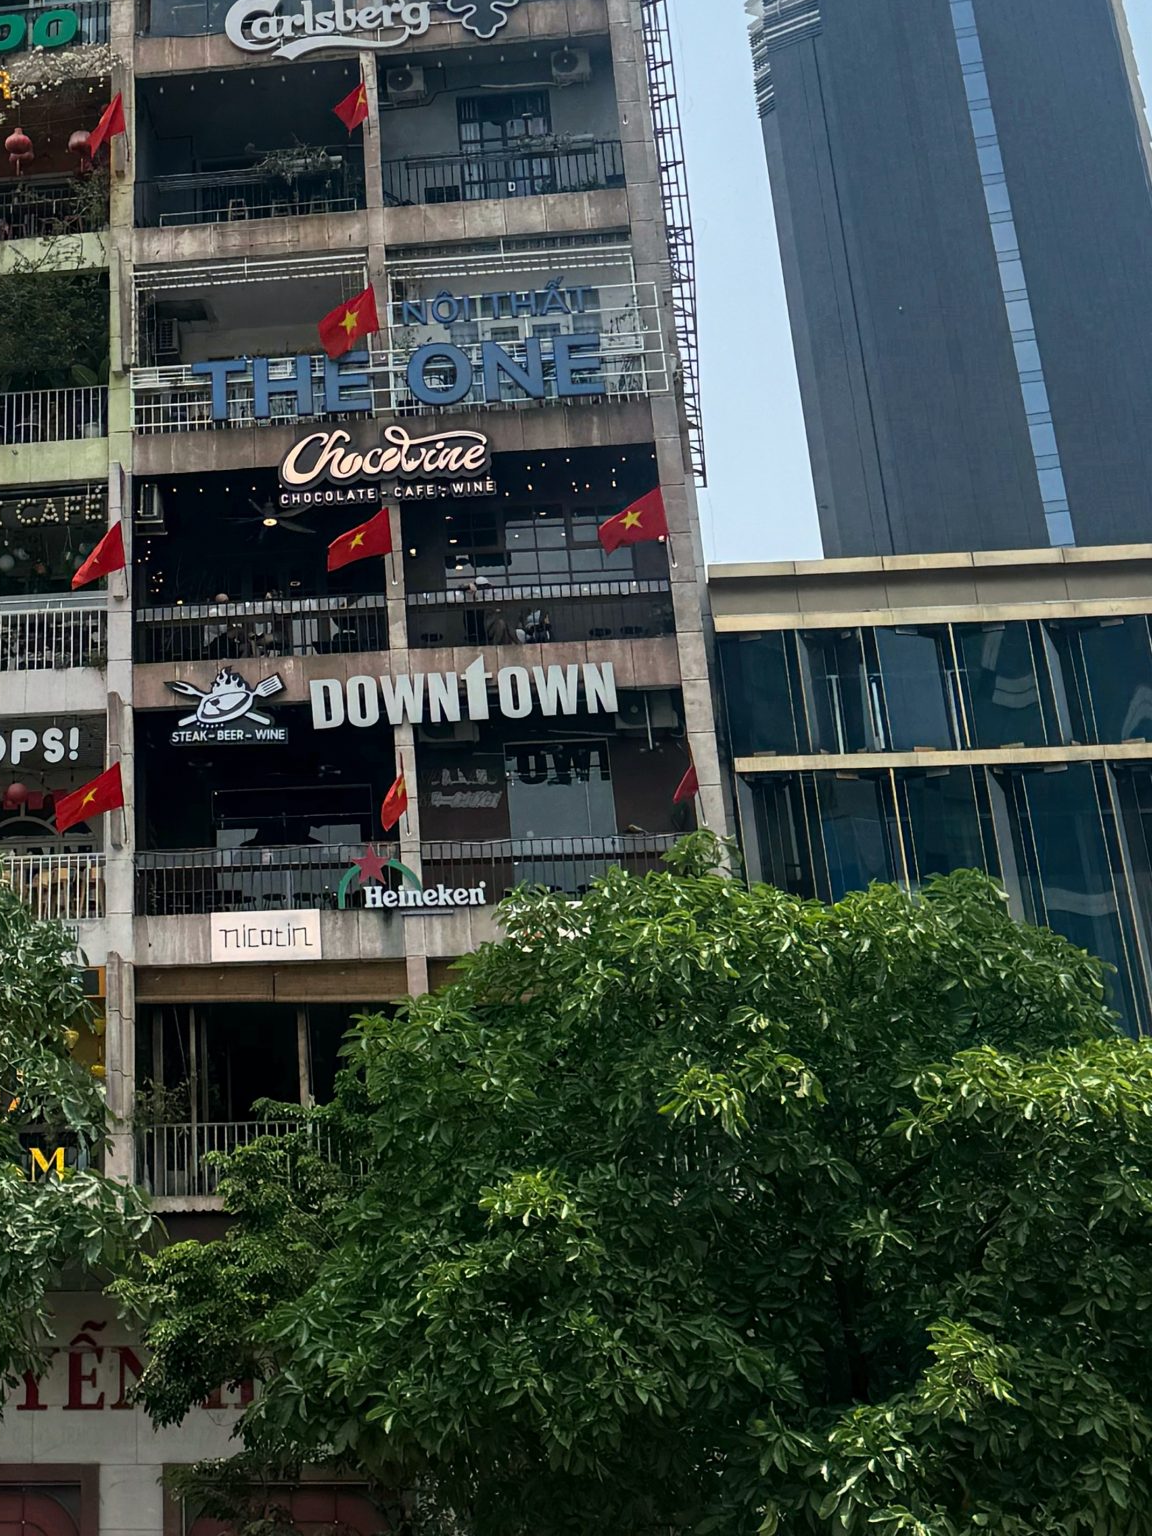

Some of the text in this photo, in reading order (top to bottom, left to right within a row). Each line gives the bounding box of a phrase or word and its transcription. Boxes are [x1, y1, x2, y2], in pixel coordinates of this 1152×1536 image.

[193, 333, 607, 421] THE ONE
[15, 485, 103, 527] CAFÉ
[280, 488, 376, 505] CHOCOLATE
[393, 484, 435, 498] CAFE
[452, 480, 495, 494] WINE
[171, 730, 208, 743] STEAK
[217, 729, 244, 742] BEER
[255, 729, 286, 741] WINE
[364, 880, 487, 909] Heineken
